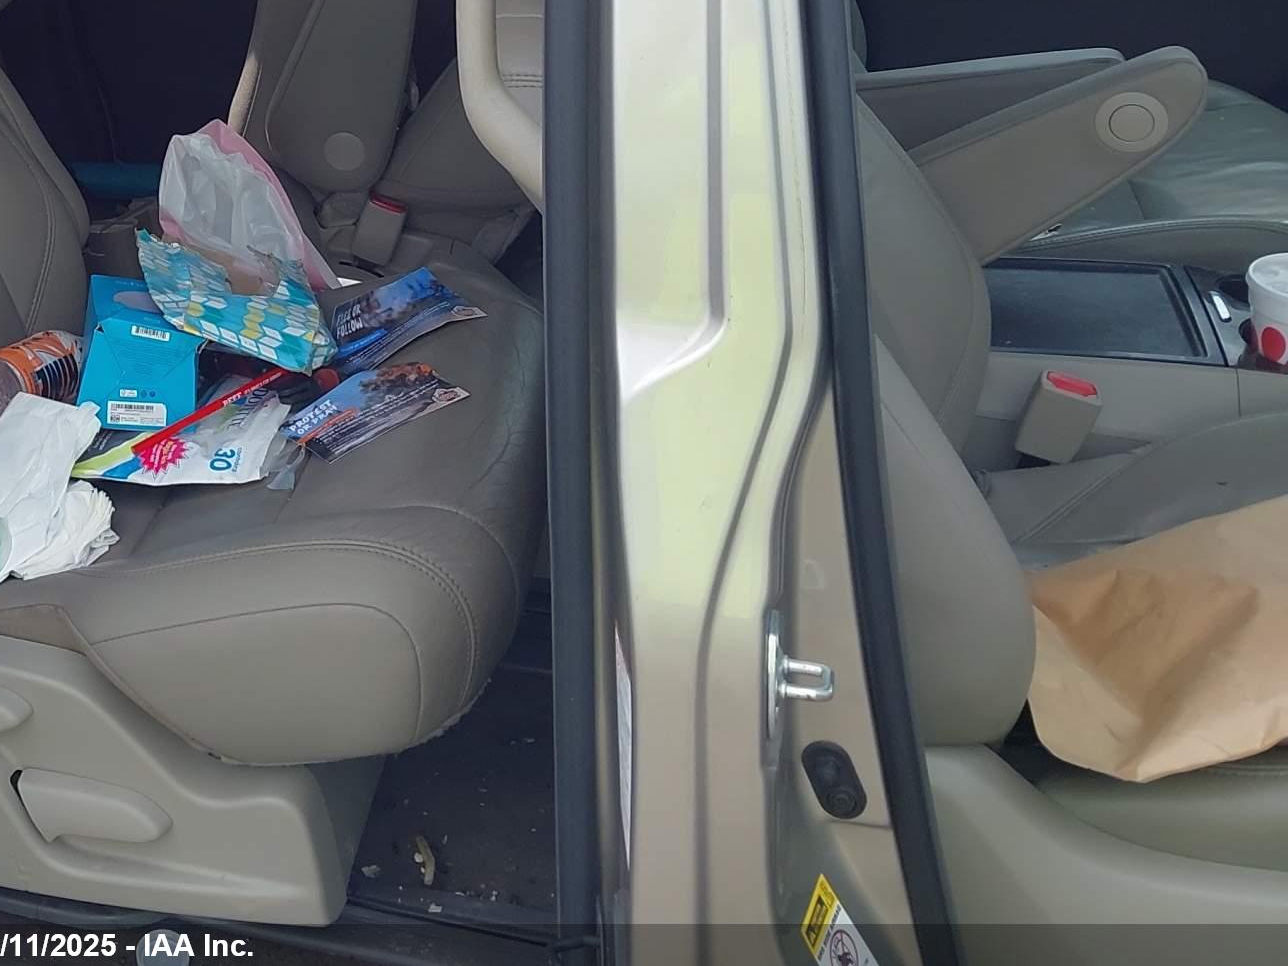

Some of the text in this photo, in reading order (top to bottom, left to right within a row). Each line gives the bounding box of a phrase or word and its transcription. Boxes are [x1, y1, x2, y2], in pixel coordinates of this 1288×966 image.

[336, 317, 363, 340] FOLLOW
[289, 399, 331, 431] PROTEST
[209, 448, 236, 471] 30
